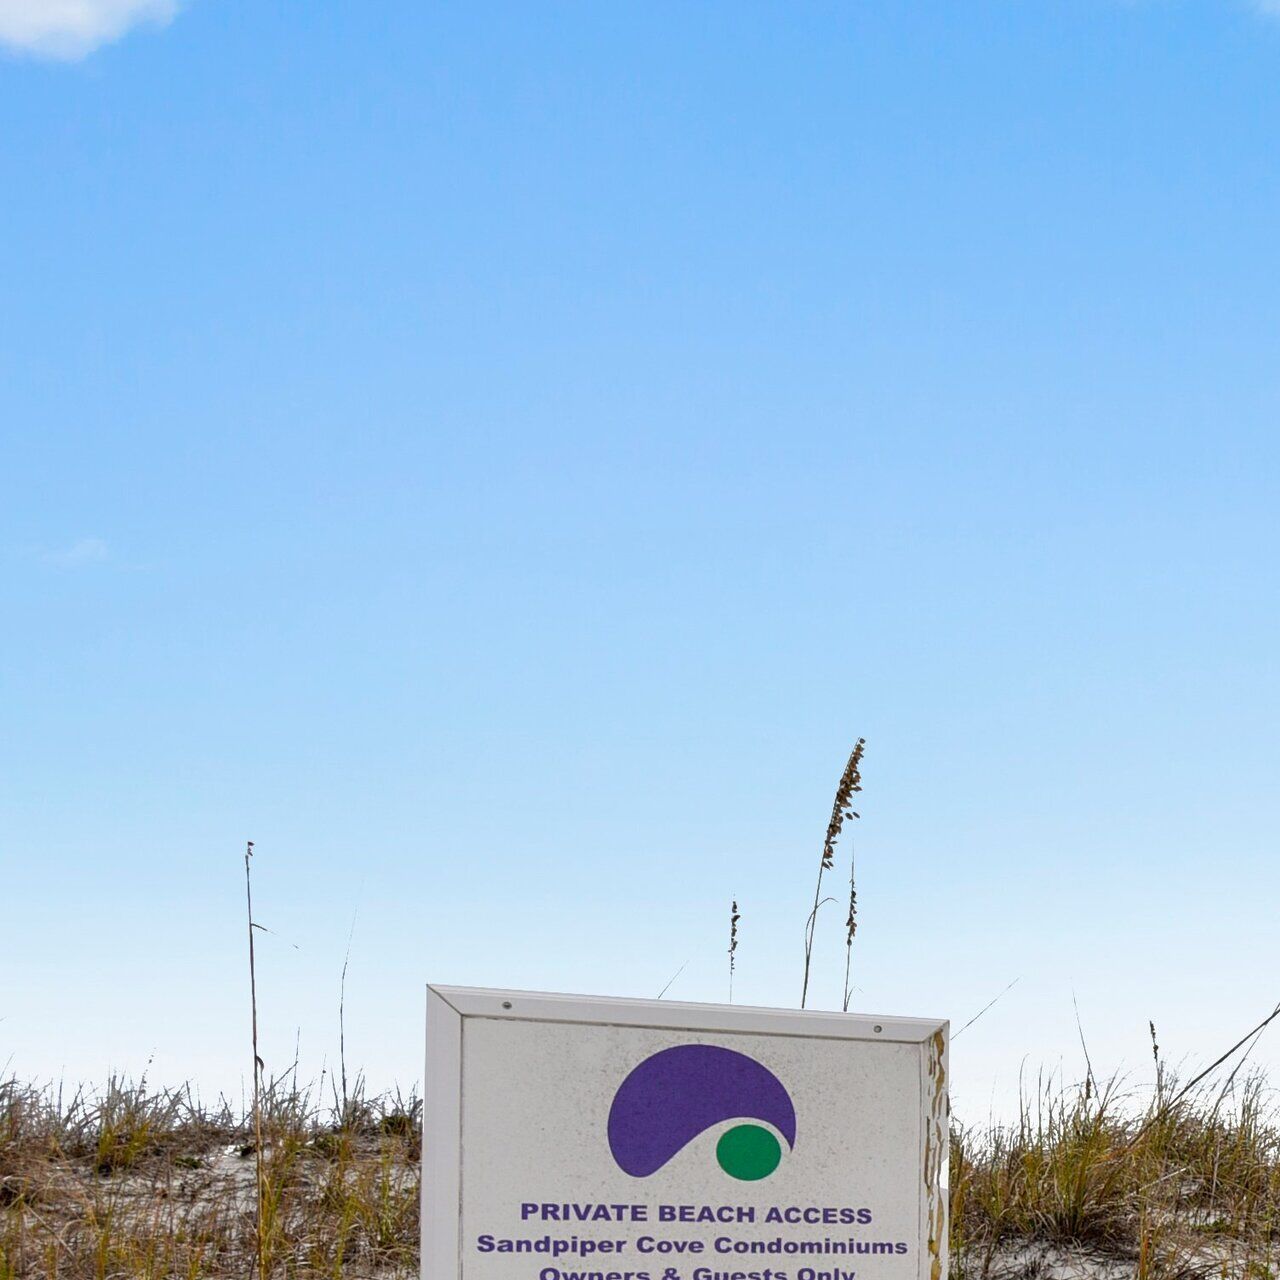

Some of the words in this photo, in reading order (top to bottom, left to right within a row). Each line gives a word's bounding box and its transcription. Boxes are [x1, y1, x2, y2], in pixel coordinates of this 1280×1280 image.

[521, 1203, 648, 1221] PRIVATE
[658, 1206, 755, 1222] BEACH
[764, 1207, 873, 1224] ACCESS
[476, 1235, 627, 1257] Sandpiper
[636, 1237, 705, 1253] Cove
[714, 1237, 908, 1254] Condominiums
